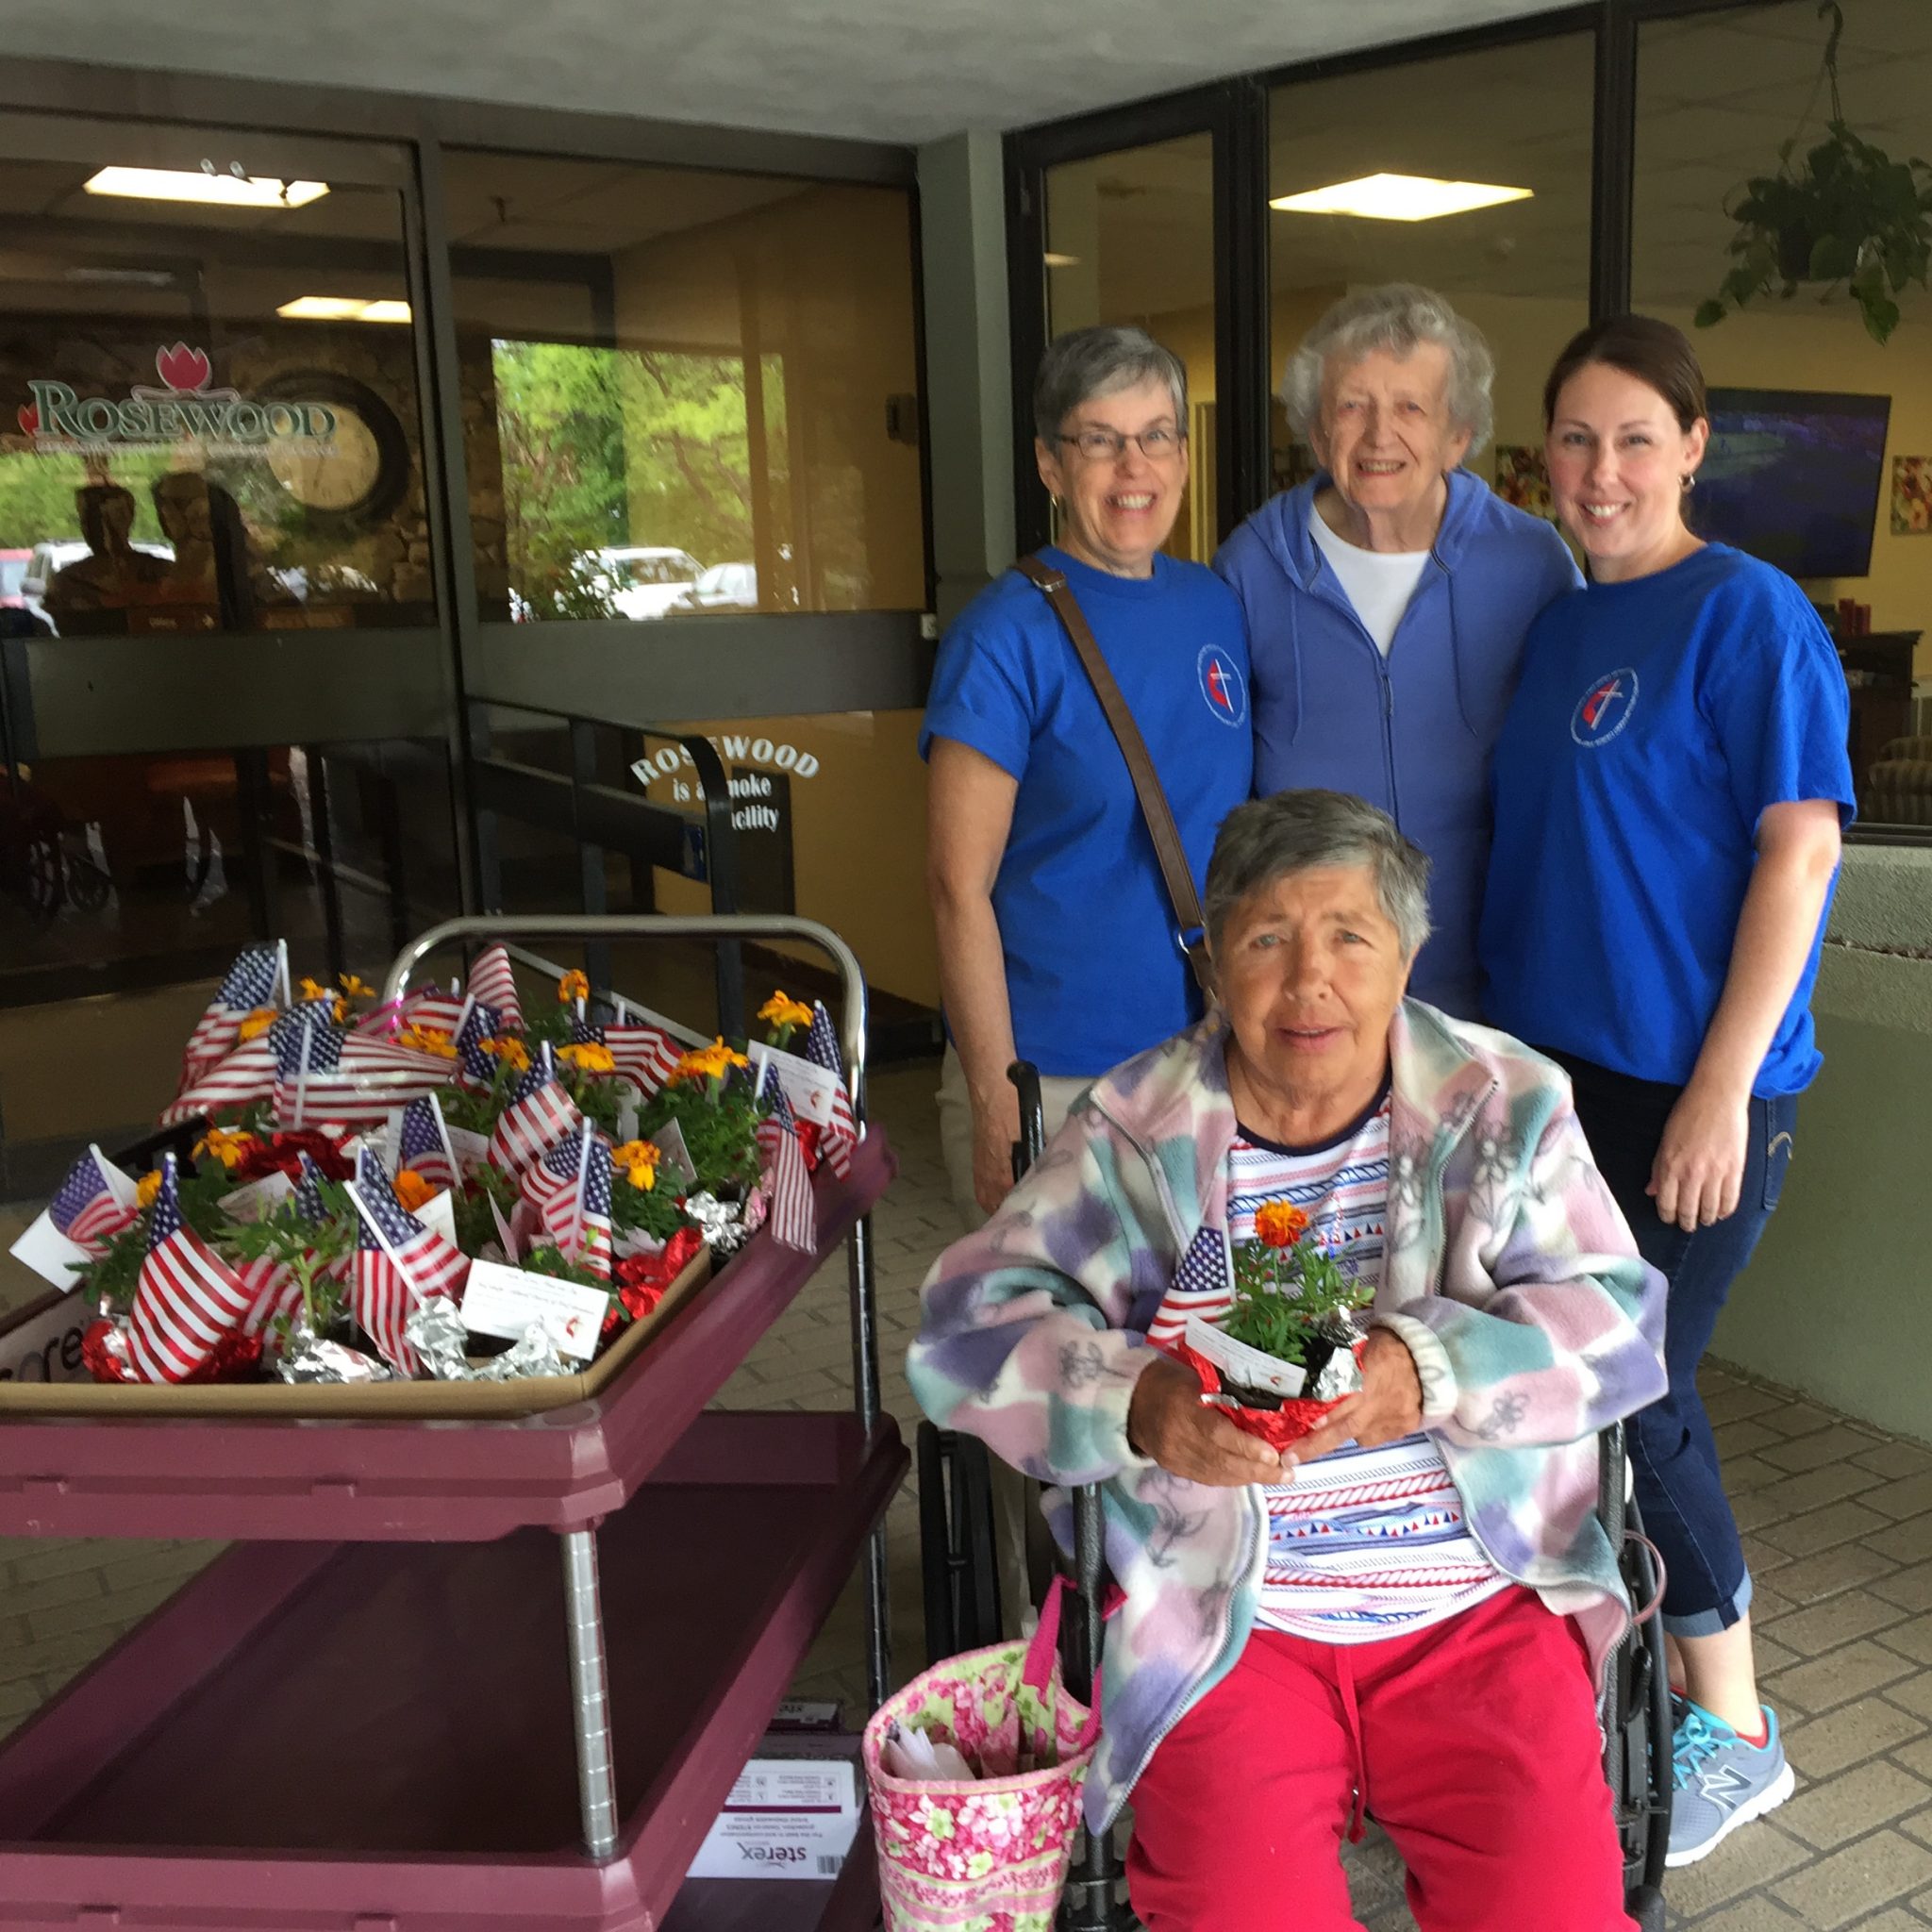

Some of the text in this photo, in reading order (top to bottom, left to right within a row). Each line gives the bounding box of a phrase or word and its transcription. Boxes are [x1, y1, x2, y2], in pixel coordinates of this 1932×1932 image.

[27, 380, 336, 441] ROSEWOOD
[674, 777, 691, 802] is
[726, 774, 772, 798] moke
[731, 805, 779, 832] cility
[737, 1841, 807, 1862] sterex
